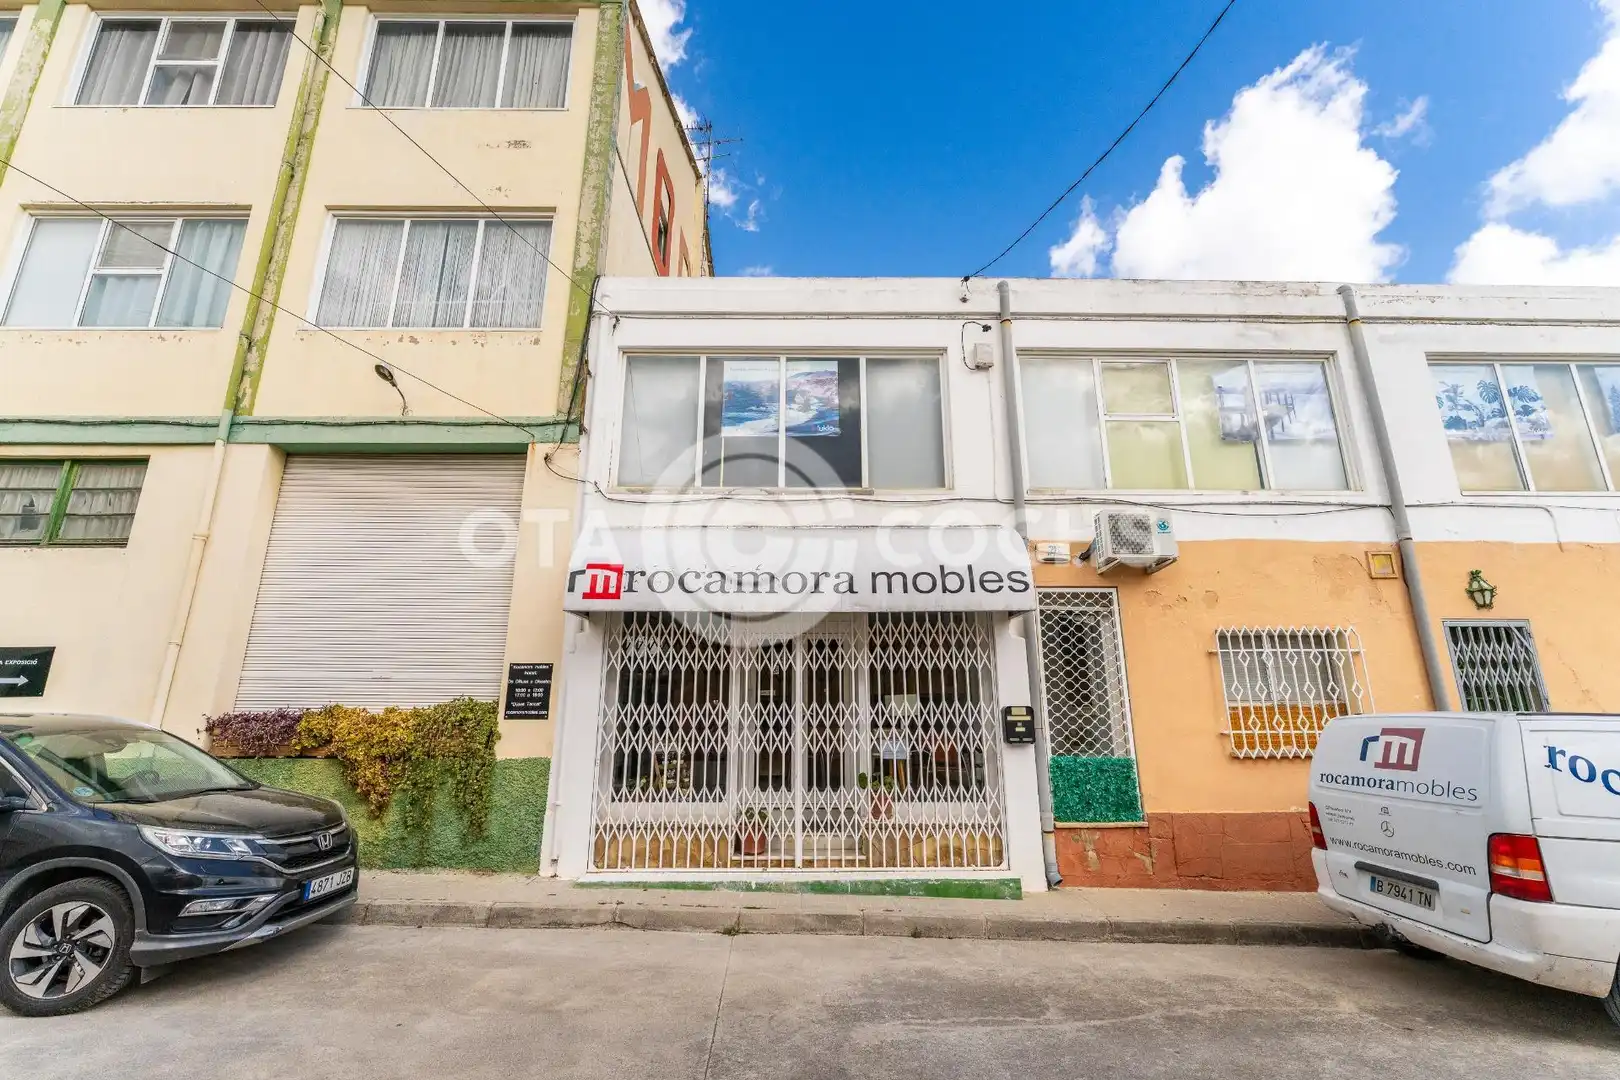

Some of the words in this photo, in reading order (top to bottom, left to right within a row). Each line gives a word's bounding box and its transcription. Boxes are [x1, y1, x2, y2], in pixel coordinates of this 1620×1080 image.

[624, 568, 858, 595] rocamora
[871, 564, 1030, 594] mobles
[1319, 772, 1478, 802] rocamoramobles
[1330, 837, 1477, 875] www.rocamoramobles.com
[311, 875, 334, 893] 4871
[1376, 880, 1384, 892] B
[1387, 882, 1413, 902] 7941
[1417, 891, 1432, 907] TN
